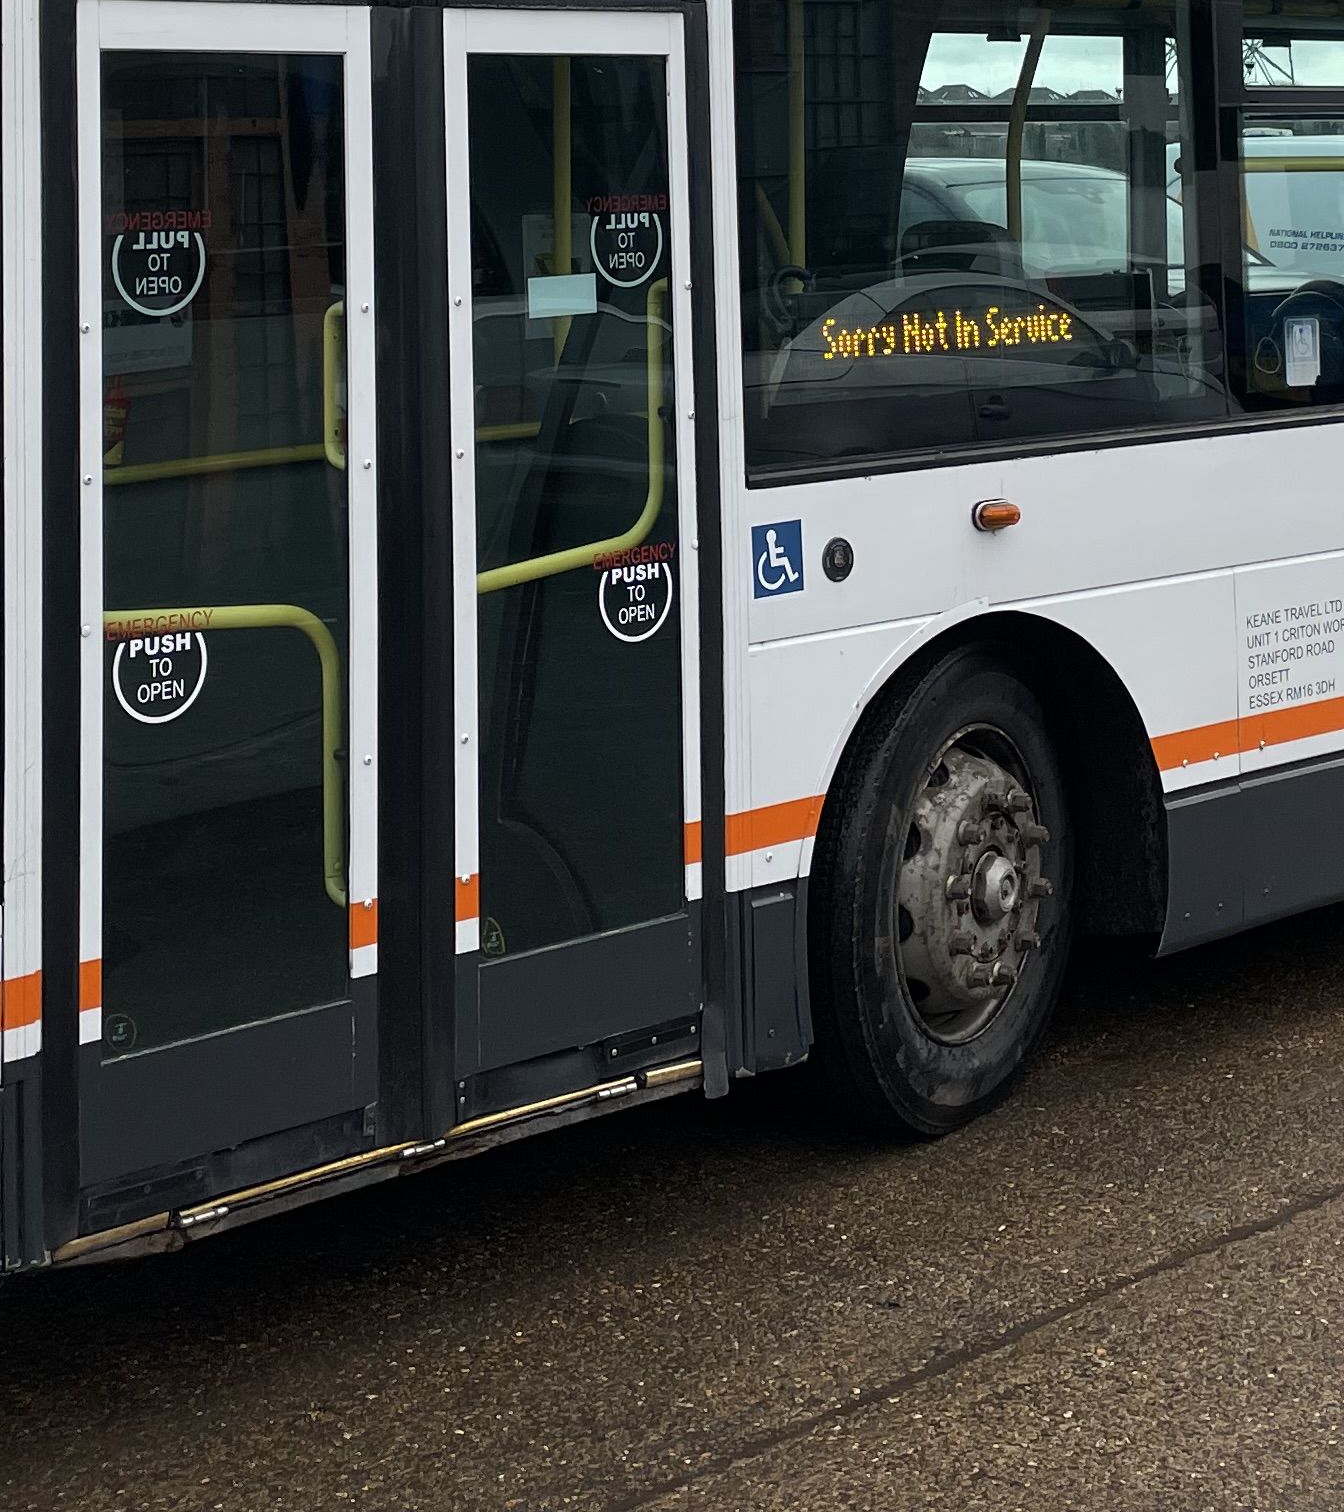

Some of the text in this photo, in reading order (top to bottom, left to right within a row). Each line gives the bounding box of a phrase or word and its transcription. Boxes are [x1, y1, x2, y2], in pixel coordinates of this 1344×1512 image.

[1268, 229, 1307, 239] NATIONAL
[1269, 240, 1298, 250] 0800
[823, 303, 1073, 360] Sorry Not In Service
[593, 542, 676, 571] EMERGENCY
[611, 562, 660, 585] PUSH
[626, 584, 646, 602] TO
[106, 609, 214, 641] EMERGENCY
[618, 603, 655, 624] OPEN
[1246, 599, 1343, 629] KEANE TRAVEL LTD
[129, 632, 191, 658] PUSH
[1247, 631, 1272, 649] UNIT
[1274, 630, 1279, 643] 1
[1282, 623, 1321, 642] CRITON
[149, 657, 173, 678] TO
[1248, 640, 1335, 669] STANFORD ROAD
[137, 678, 185, 704] OPEN
[1249, 668, 1291, 689] ORSETT
[1249, 678, 1336, 710] ESSEX RM16 3DH
